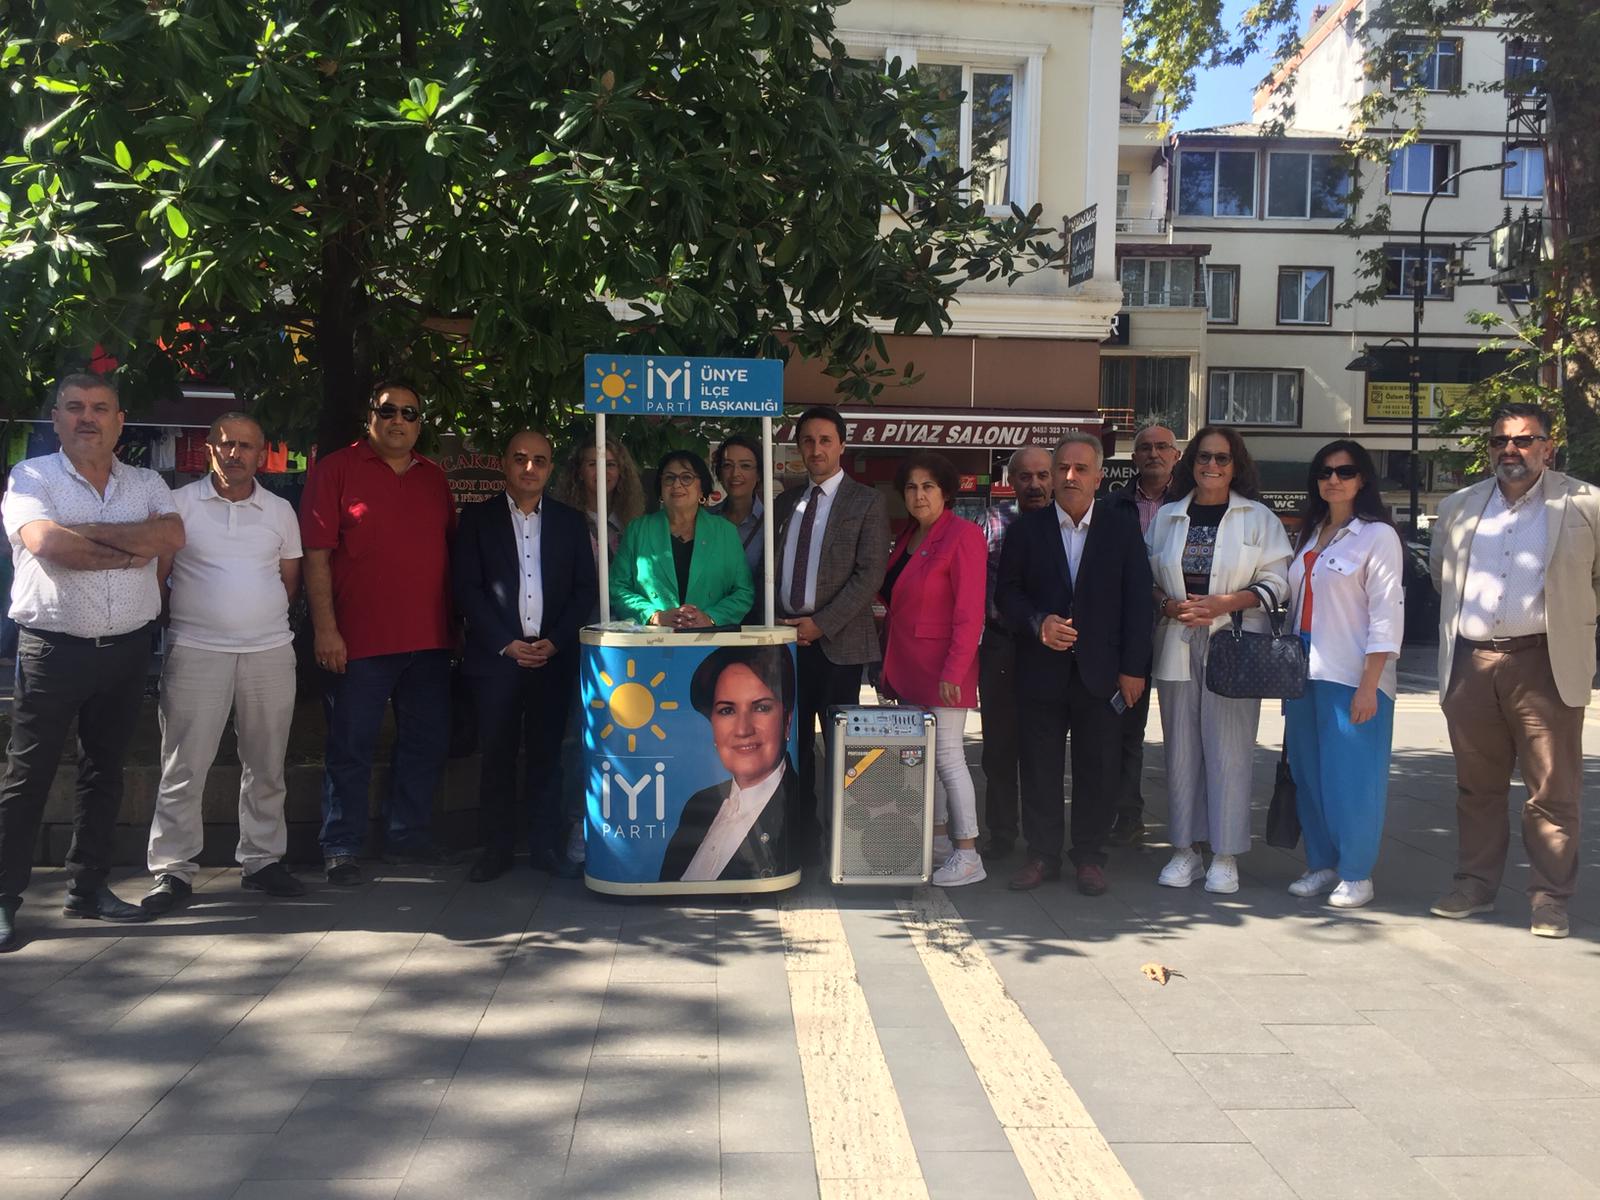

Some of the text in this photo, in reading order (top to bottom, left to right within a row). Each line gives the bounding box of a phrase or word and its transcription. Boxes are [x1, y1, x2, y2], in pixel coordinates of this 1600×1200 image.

[701, 365, 748, 382] ÜNYE
[701, 383, 730, 399] İLÇE
[647, 401, 691, 412] PARTİ
[701, 399, 778, 413] BAŞKANLIĞI
[863, 427, 876, 442] &
[880, 421, 944, 443] PİYAZ
[946, 425, 1029, 445] SALONU
[1103, 466, 1140, 478] RMEN
[1274, 500, 1295, 508] WC
[602, 822, 665, 839] PARTİ
